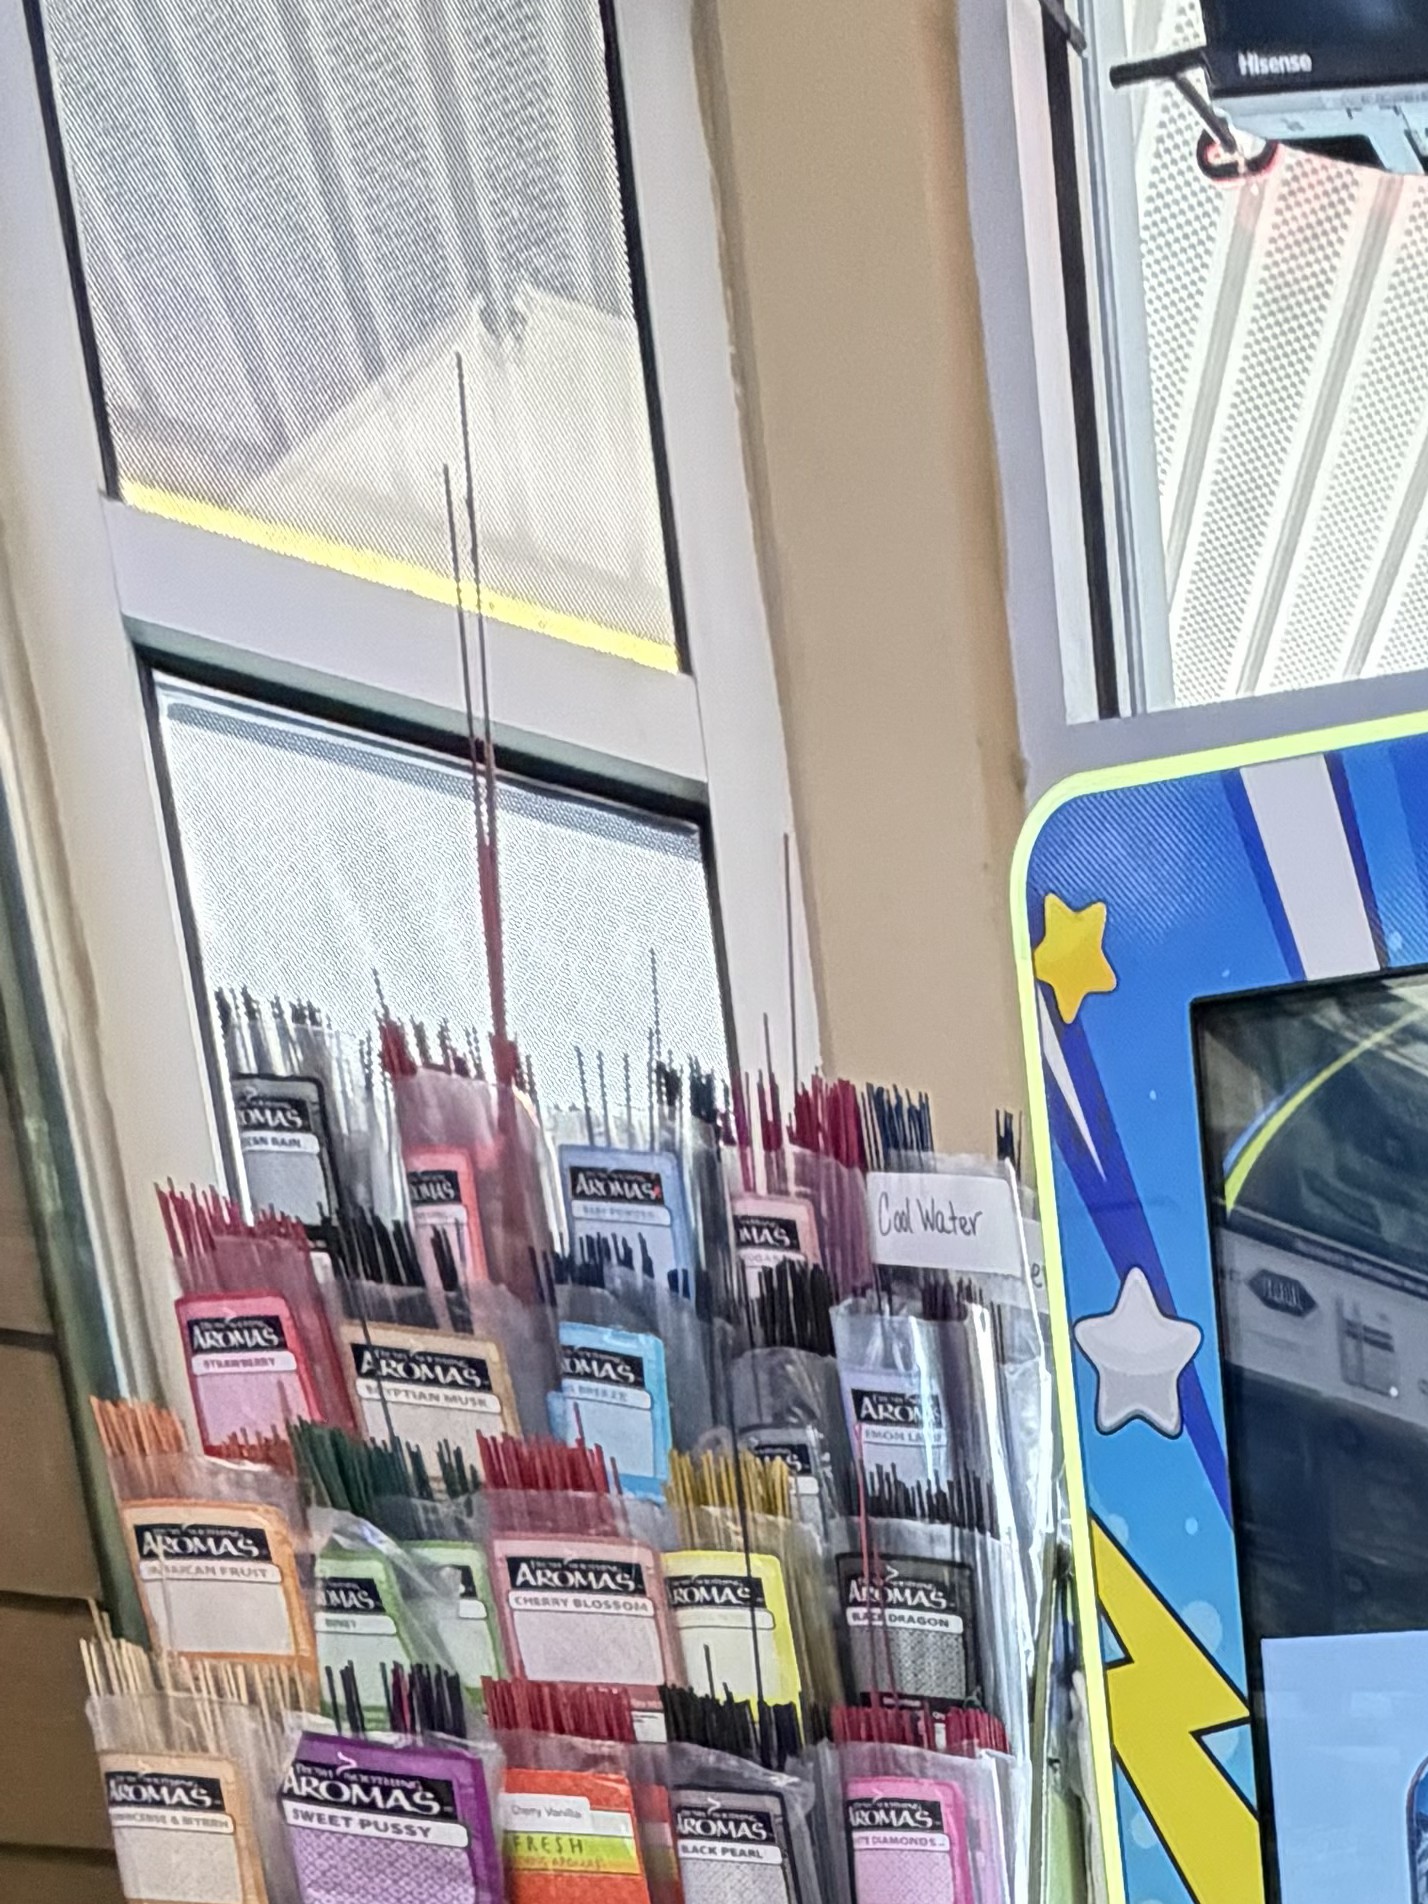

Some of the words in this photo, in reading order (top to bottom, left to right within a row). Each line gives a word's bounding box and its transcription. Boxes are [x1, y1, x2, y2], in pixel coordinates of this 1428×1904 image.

[1238, 50, 1312, 77] Hisense
[573, 1176, 657, 1199] AROMAS
[878, 1192, 914, 1236] Cool
[919, 1198, 983, 1237] Water
[193, 1324, 280, 1350] AROMAS
[360, 1353, 481, 1387] AROMAS
[142, 1532, 259, 1558] AROMAS
[516, 1563, 634, 1593] AROMAS
[513, 1595, 570, 1610] CHERRY
[573, 1597, 649, 1613] BLOSSOM
[848, 1579, 946, 1609] AROMAS
[887, 1613, 950, 1628] DRAGON
[109, 1780, 212, 1808] AROMAS
[283, 1770, 441, 1816] AROMAS
[293, 1810, 352, 1829] SWEET
[360, 1818, 433, 1839] PUSSY
[721, 1847, 764, 1859] PEARL
